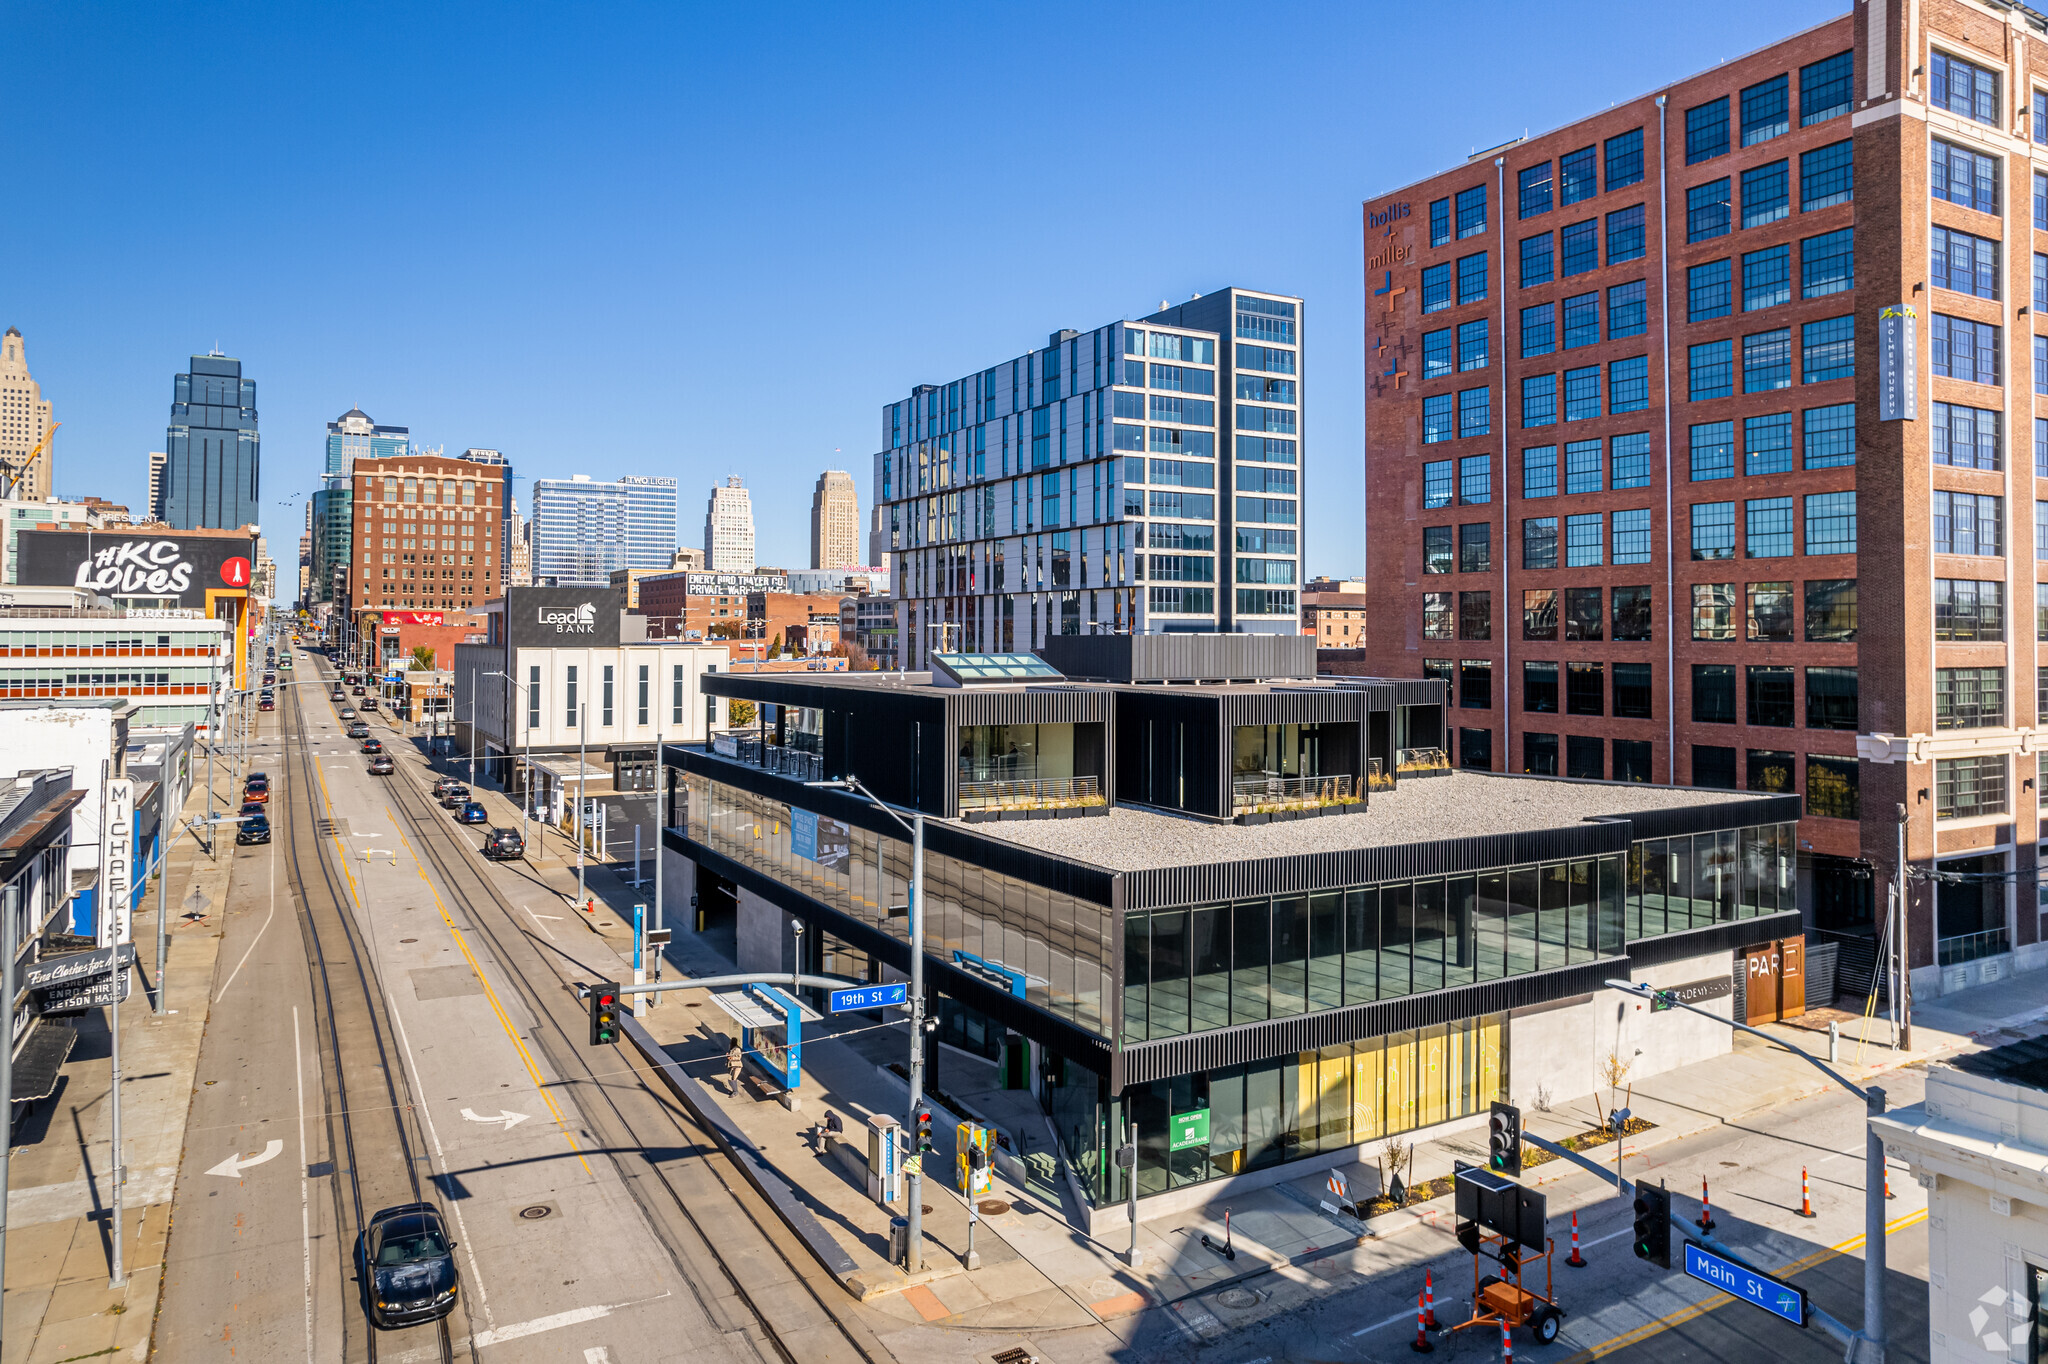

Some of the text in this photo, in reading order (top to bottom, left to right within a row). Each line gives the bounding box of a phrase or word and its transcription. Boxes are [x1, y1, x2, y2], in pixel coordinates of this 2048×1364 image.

[1369, 203, 1411, 228] hollis
[1369, 245, 1412, 269] miller
[628, 476, 675, 486] TWO LIGHT
[100, 513, 159, 523] PRESIDENT
[94, 541, 180, 570] #KC
[688, 574, 715, 585] EMERY
[738, 576, 769, 587] THAYER
[126, 608, 191, 618] BARKLEY
[538, 606, 578, 624] Lead
[556, 624, 595, 634] BANK
[28, 970, 52, 985] Fine
[88, 957, 104, 976] for
[44, 993, 120, 1010] STETSON HAT
[841, 991, 883, 1006] 19th St
[1698, 1257, 1764, 1300] Main St
